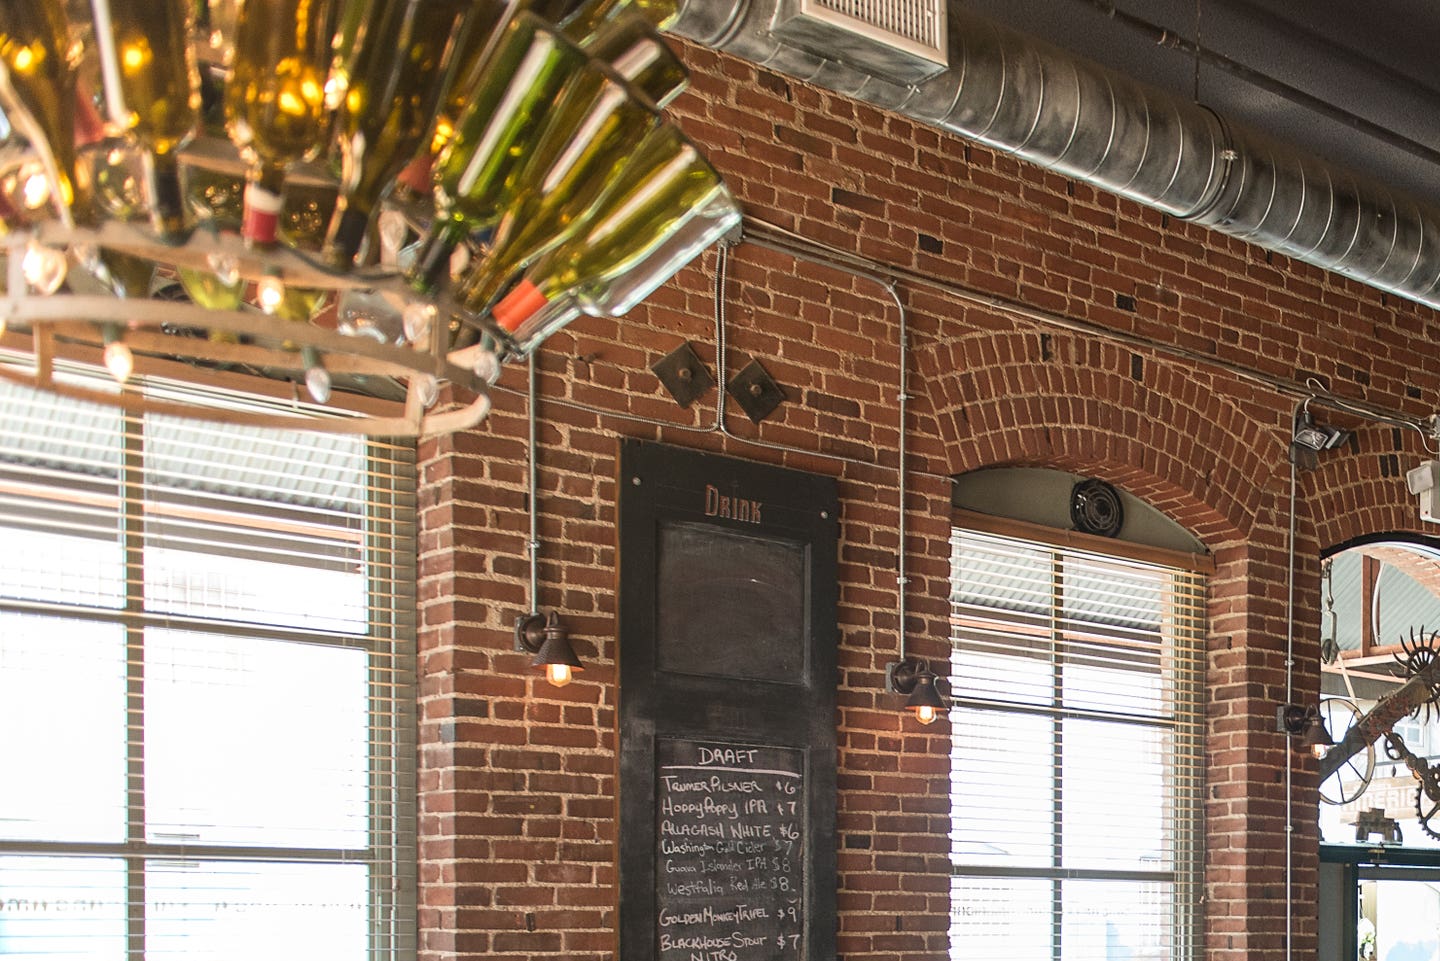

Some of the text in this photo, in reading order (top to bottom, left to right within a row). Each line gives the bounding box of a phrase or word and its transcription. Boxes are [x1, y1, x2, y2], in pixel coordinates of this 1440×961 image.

[698, 747, 758, 765] DRAFT
[744, 799, 768, 815] IPA
[661, 820, 799, 840] ALLAGASH WHITE $6
[661, 838, 715, 857] Washington
[746, 857, 767, 870] IPA
[778, 907, 797, 922] $9
[777, 933, 800, 950] $7
